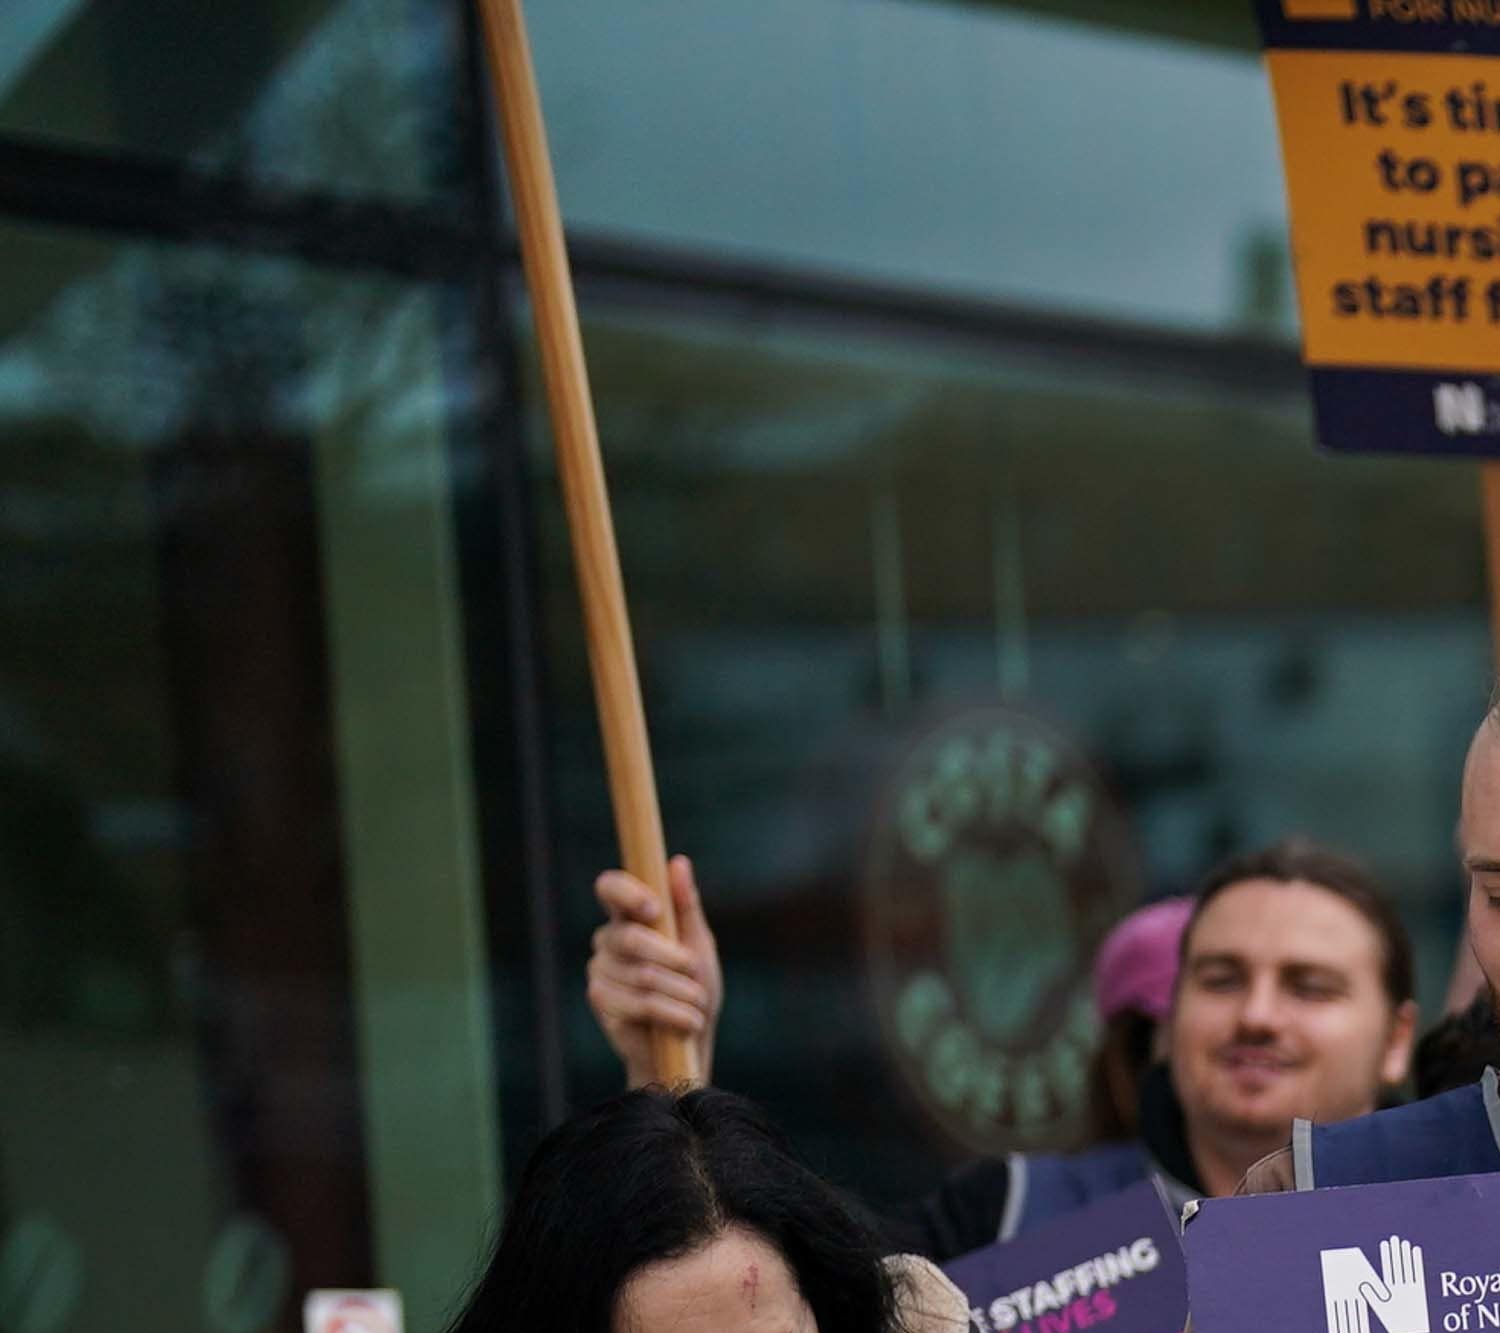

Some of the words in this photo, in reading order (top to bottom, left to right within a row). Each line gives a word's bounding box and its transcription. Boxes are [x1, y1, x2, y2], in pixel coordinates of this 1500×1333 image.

[1337, 79, 1432, 130] It's
[1377, 149, 1441, 193] to
[1331, 274, 1474, 321] staff
[988, 1237, 1160, 1332] STAFFING
[1443, 1303, 1473, 1332] of
